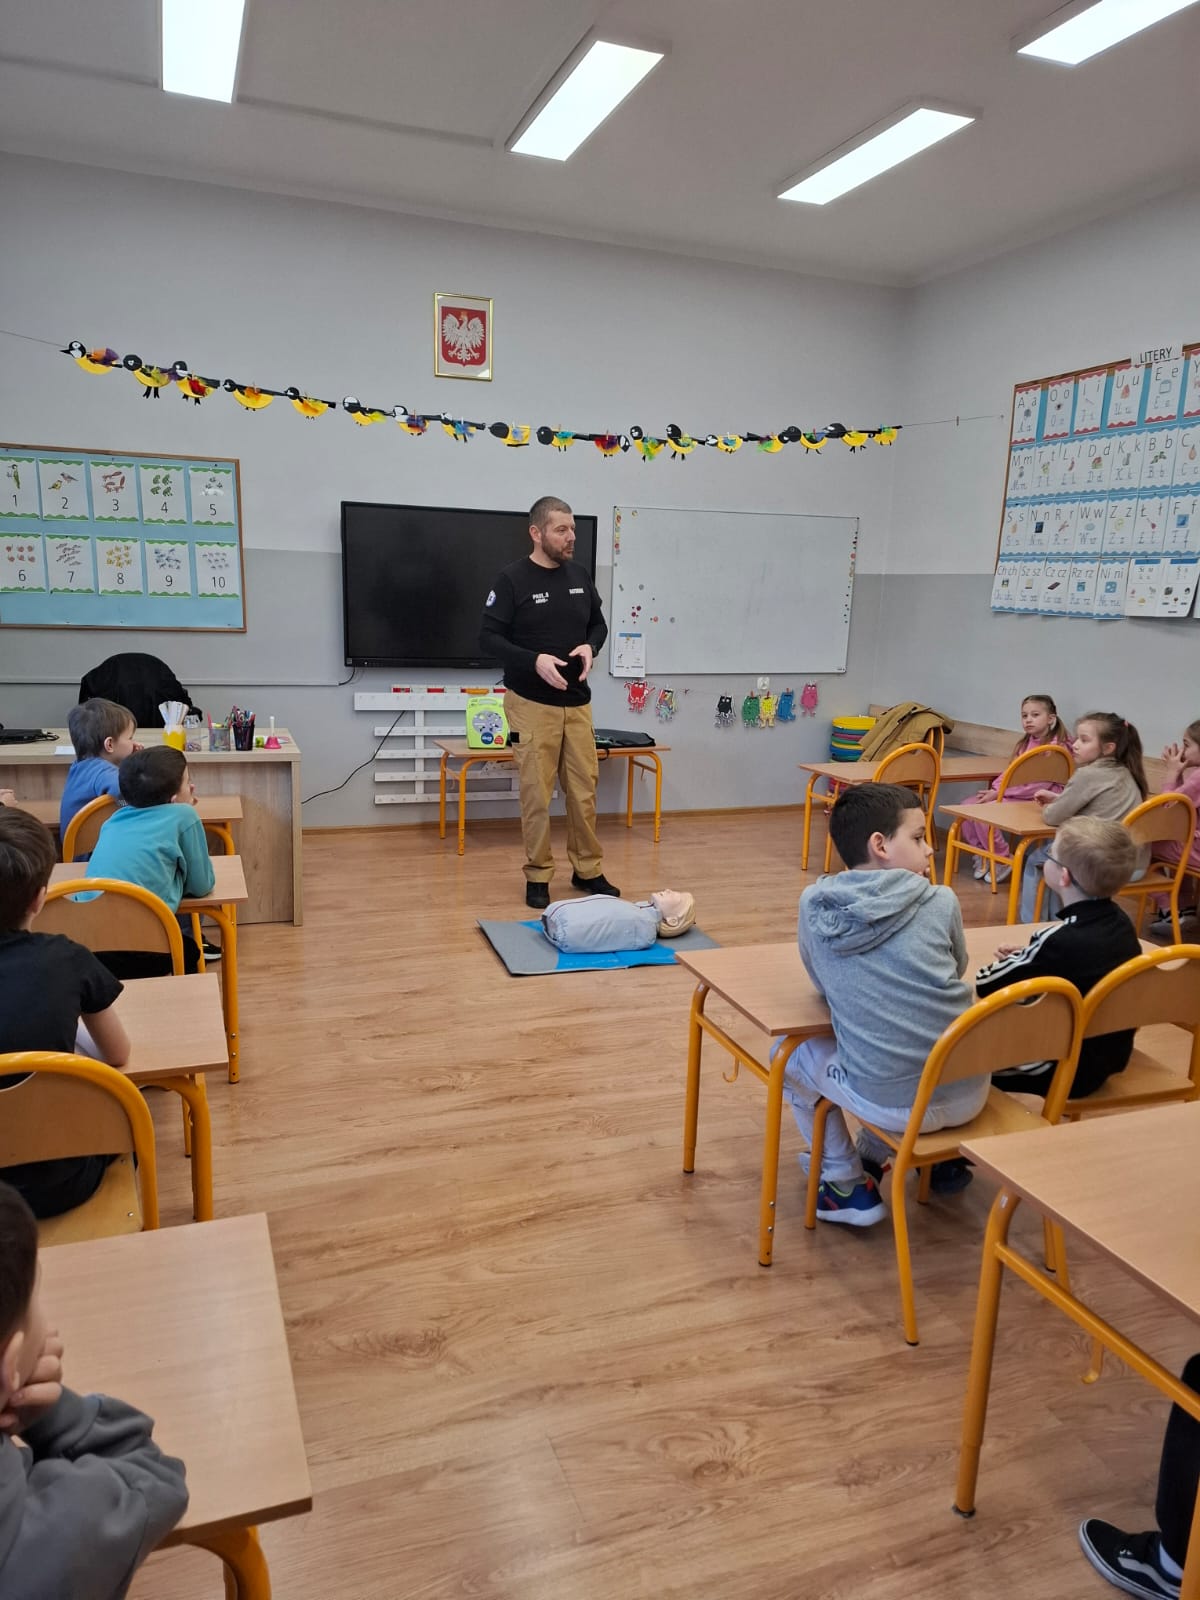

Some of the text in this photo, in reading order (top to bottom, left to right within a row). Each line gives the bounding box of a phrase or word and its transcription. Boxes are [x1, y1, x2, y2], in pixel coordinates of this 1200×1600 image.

[1140, 346, 1172, 363] LITERY
[1156, 367, 1179, 381] E e
[1116, 375, 1139, 388] U u
[1050, 389, 1069, 401] O o
[1018, 397, 1025, 408] A
[1149, 434, 1172, 451] B b
[1182, 433, 1190, 447] C
[1088, 442, 1111, 457] D d
[1118, 439, 1140, 454] K k
[1012, 456, 1032, 467] M m
[12, 494, 18, 507] 1
[61, 497, 69, 509] 2
[112, 499, 119, 511] 3
[160, 501, 168, 513] 4
[209, 504, 217, 516] 5
[1080, 507, 1103, 519] W w
[1109, 505, 1132, 518] Z z
[1173, 500, 1197, 515] F f
[1008, 511, 1024, 523] S s
[1030, 510, 1050, 521] N n
[1055, 508, 1074, 520] R r
[18, 569, 26, 581] 6
[1021, 565, 1041, 576] Sz sz
[1045, 567, 1067, 578] Cz cz
[1072, 568, 1094, 578] Rz rz
[1101, 567, 1111, 579] Ni
[1114, 567, 1124, 579] ni
[67, 571, 74, 583] 7
[117, 572, 125, 585] 8
[165, 575, 173, 587] 9
[212, 576, 226, 588] 10
